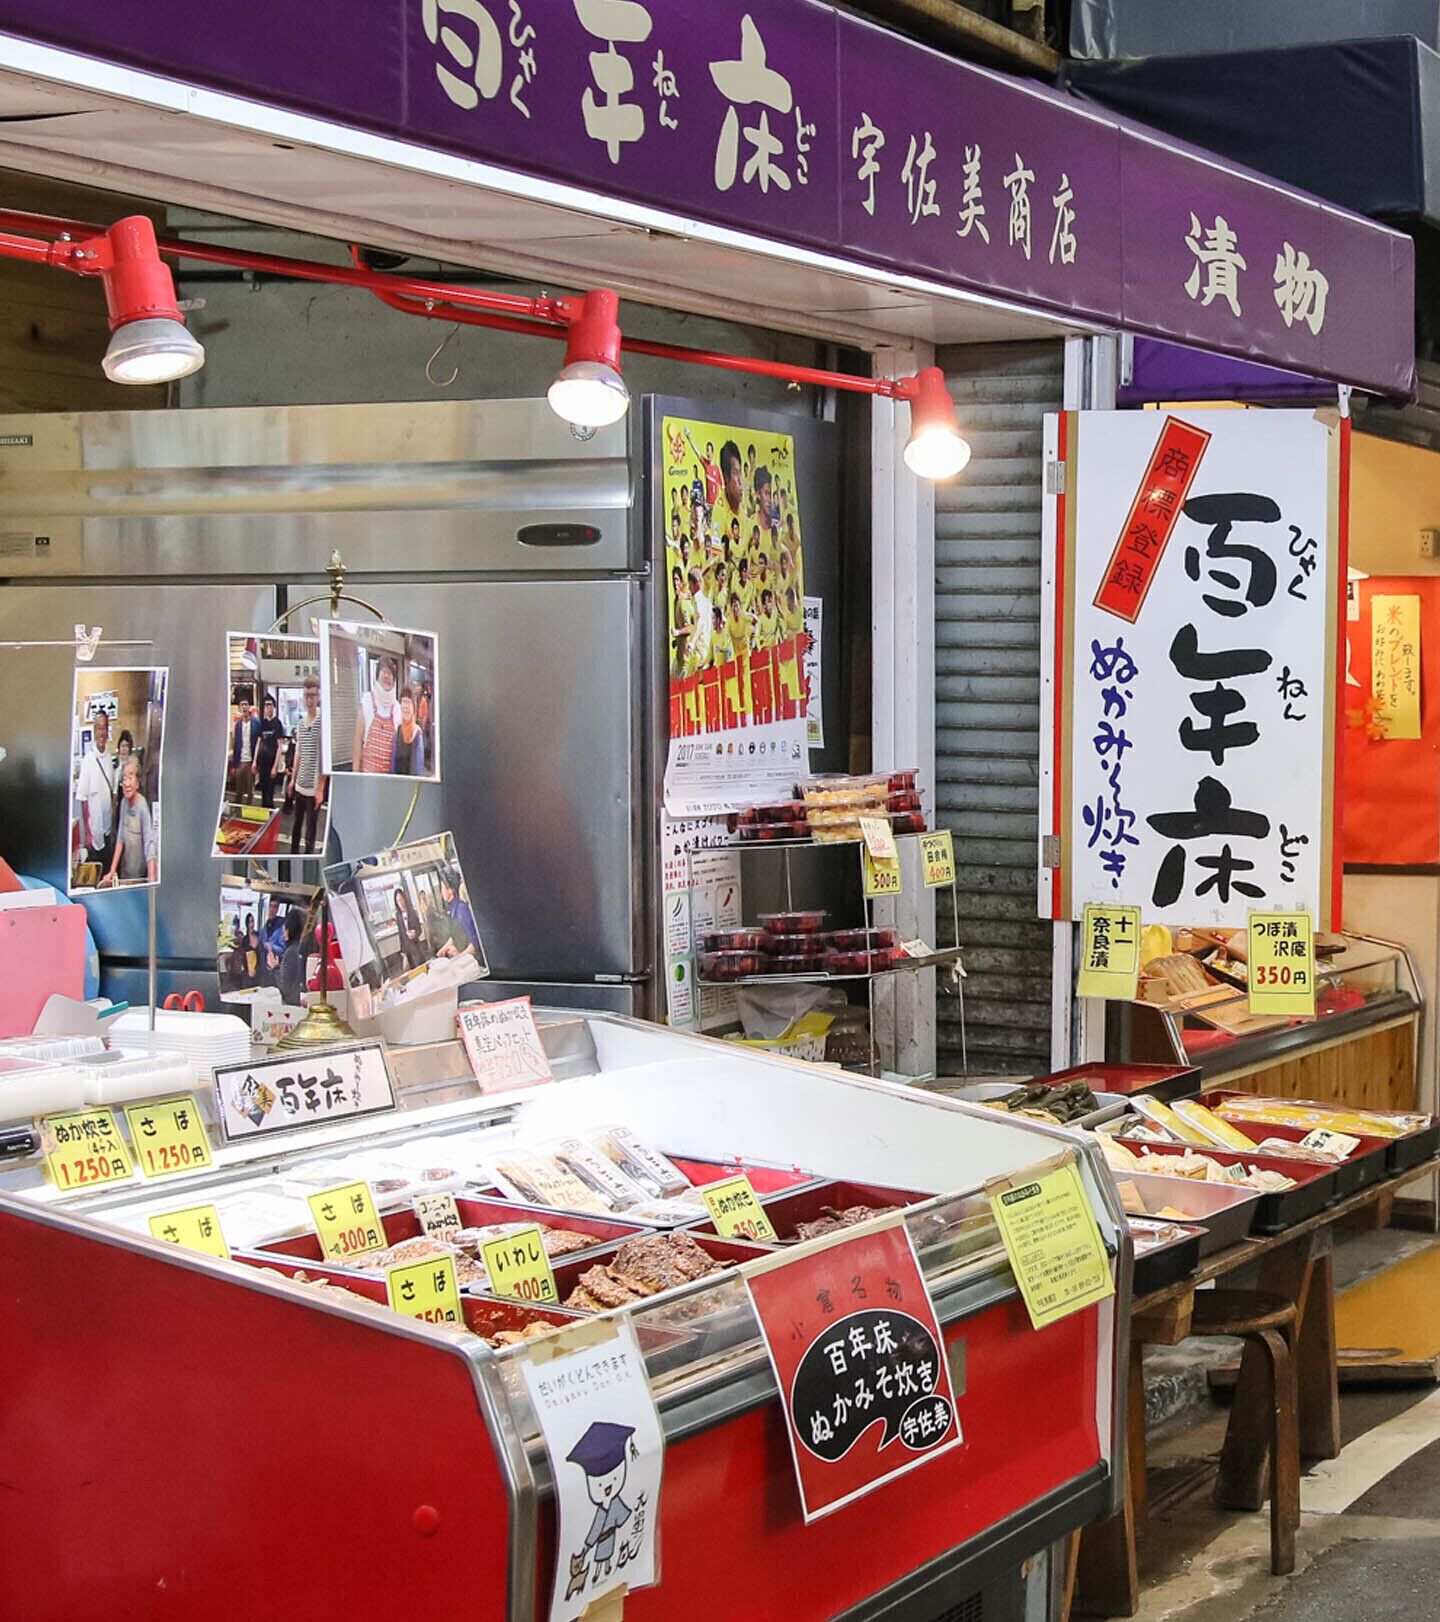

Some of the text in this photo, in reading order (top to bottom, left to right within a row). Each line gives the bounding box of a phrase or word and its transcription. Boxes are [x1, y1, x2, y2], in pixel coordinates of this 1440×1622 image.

[852, 112, 1078, 266] 宇佐美商店
[1184, 212, 1330, 336] 漬物
[1107, 446, 1190, 597] 商標登録
[1288, 525, 1318, 601] ひゃく
[1146, 493, 1282, 908] 百年床
[1276, 666, 1308, 721] ねん
[1082, 637, 1140, 889] ぬかみそ炊き
[1280, 824, 1309, 883] どこ
[1090, 916, 1111, 969] 奈良漬
[1273, 940, 1307, 957] 沢庵
[1256, 965, 1307, 986] 350円
[276, 1068, 347, 1114] 百年床
[56, 1117, 113, 1144] ぬか炊き
[496, 1243, 540, 1272] いわし
[823, 1319, 898, 1376] 百年床
[810, 1359, 934, 1445] ぬかみそ炊き
[903, 1402, 950, 1445] 宇佐美
